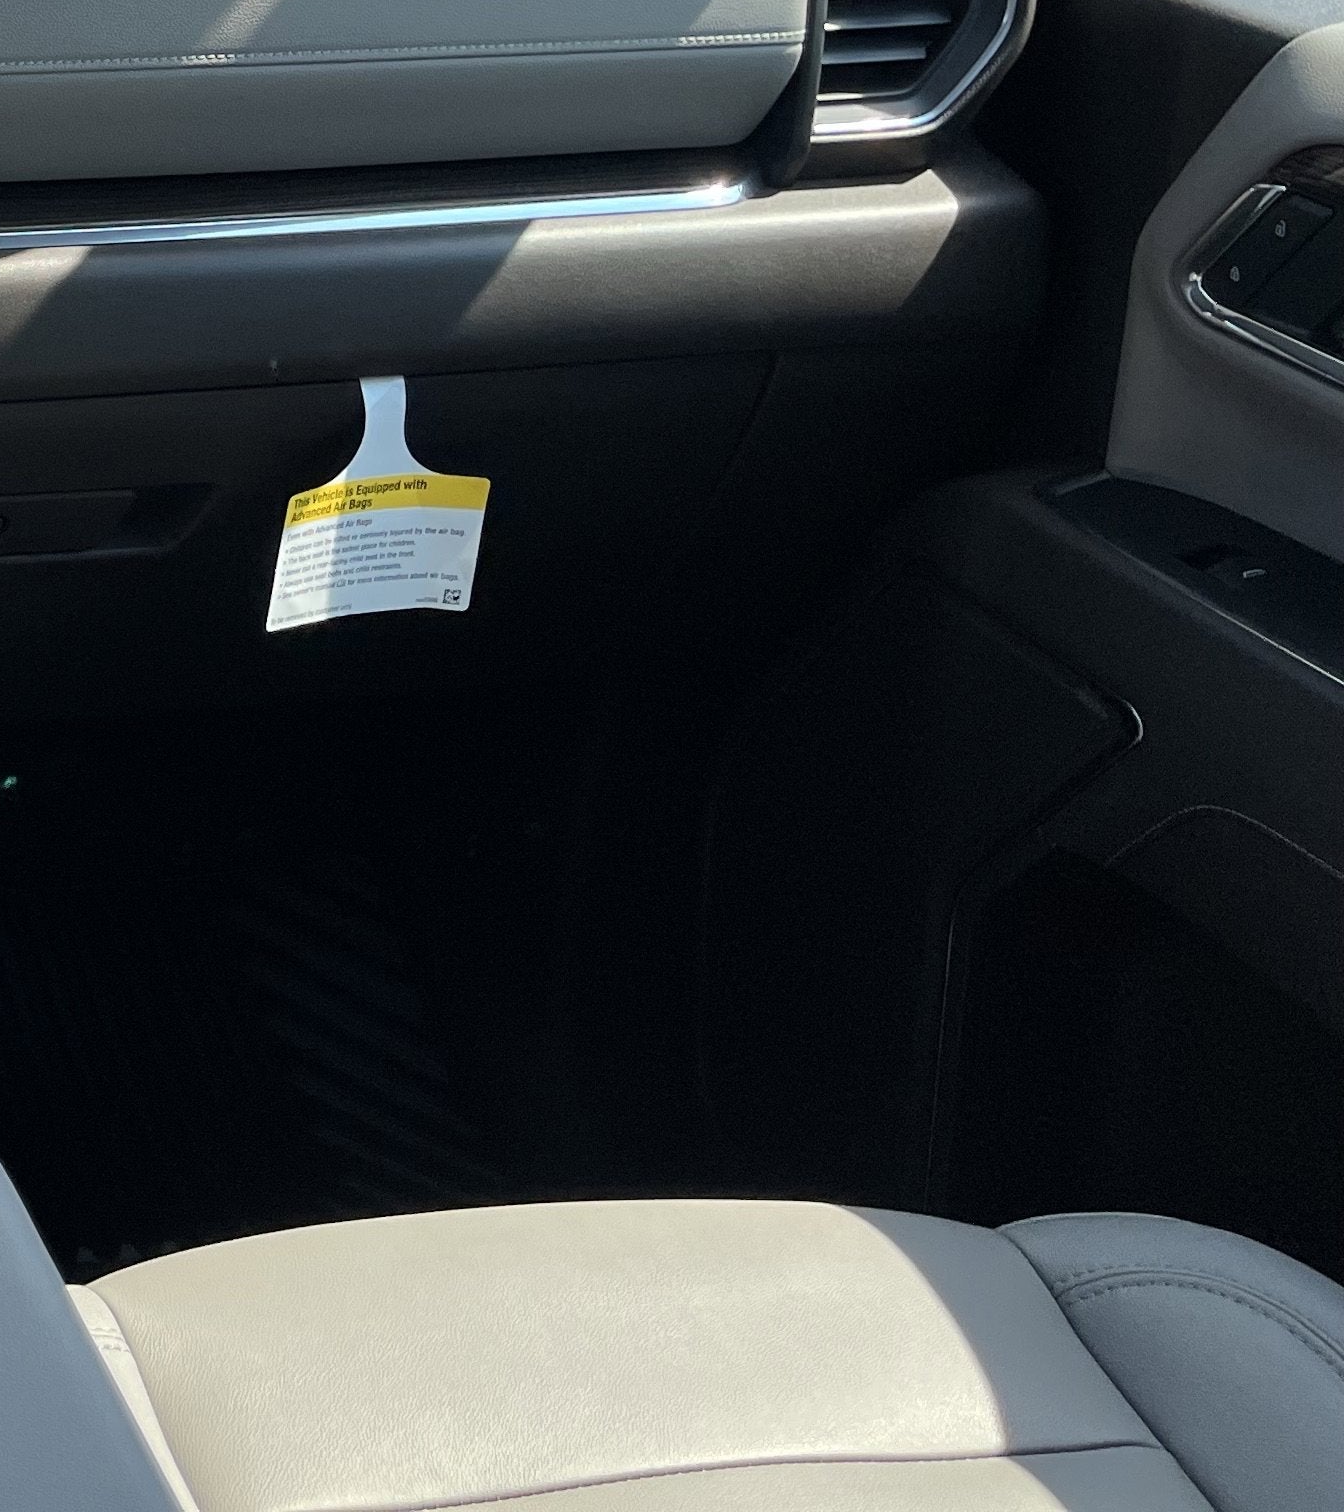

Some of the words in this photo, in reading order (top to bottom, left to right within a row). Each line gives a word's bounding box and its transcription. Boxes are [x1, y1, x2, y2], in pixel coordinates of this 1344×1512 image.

[294, 497, 311, 509] This
[312, 488, 344, 504] Vehicle
[345, 486, 354, 497] is
[356, 480, 402, 496] Equipped
[404, 479, 427, 490] with
[291, 504, 333, 523] Advanced
[333, 500, 348, 512] Air
[348, 498, 373, 510] Bags
